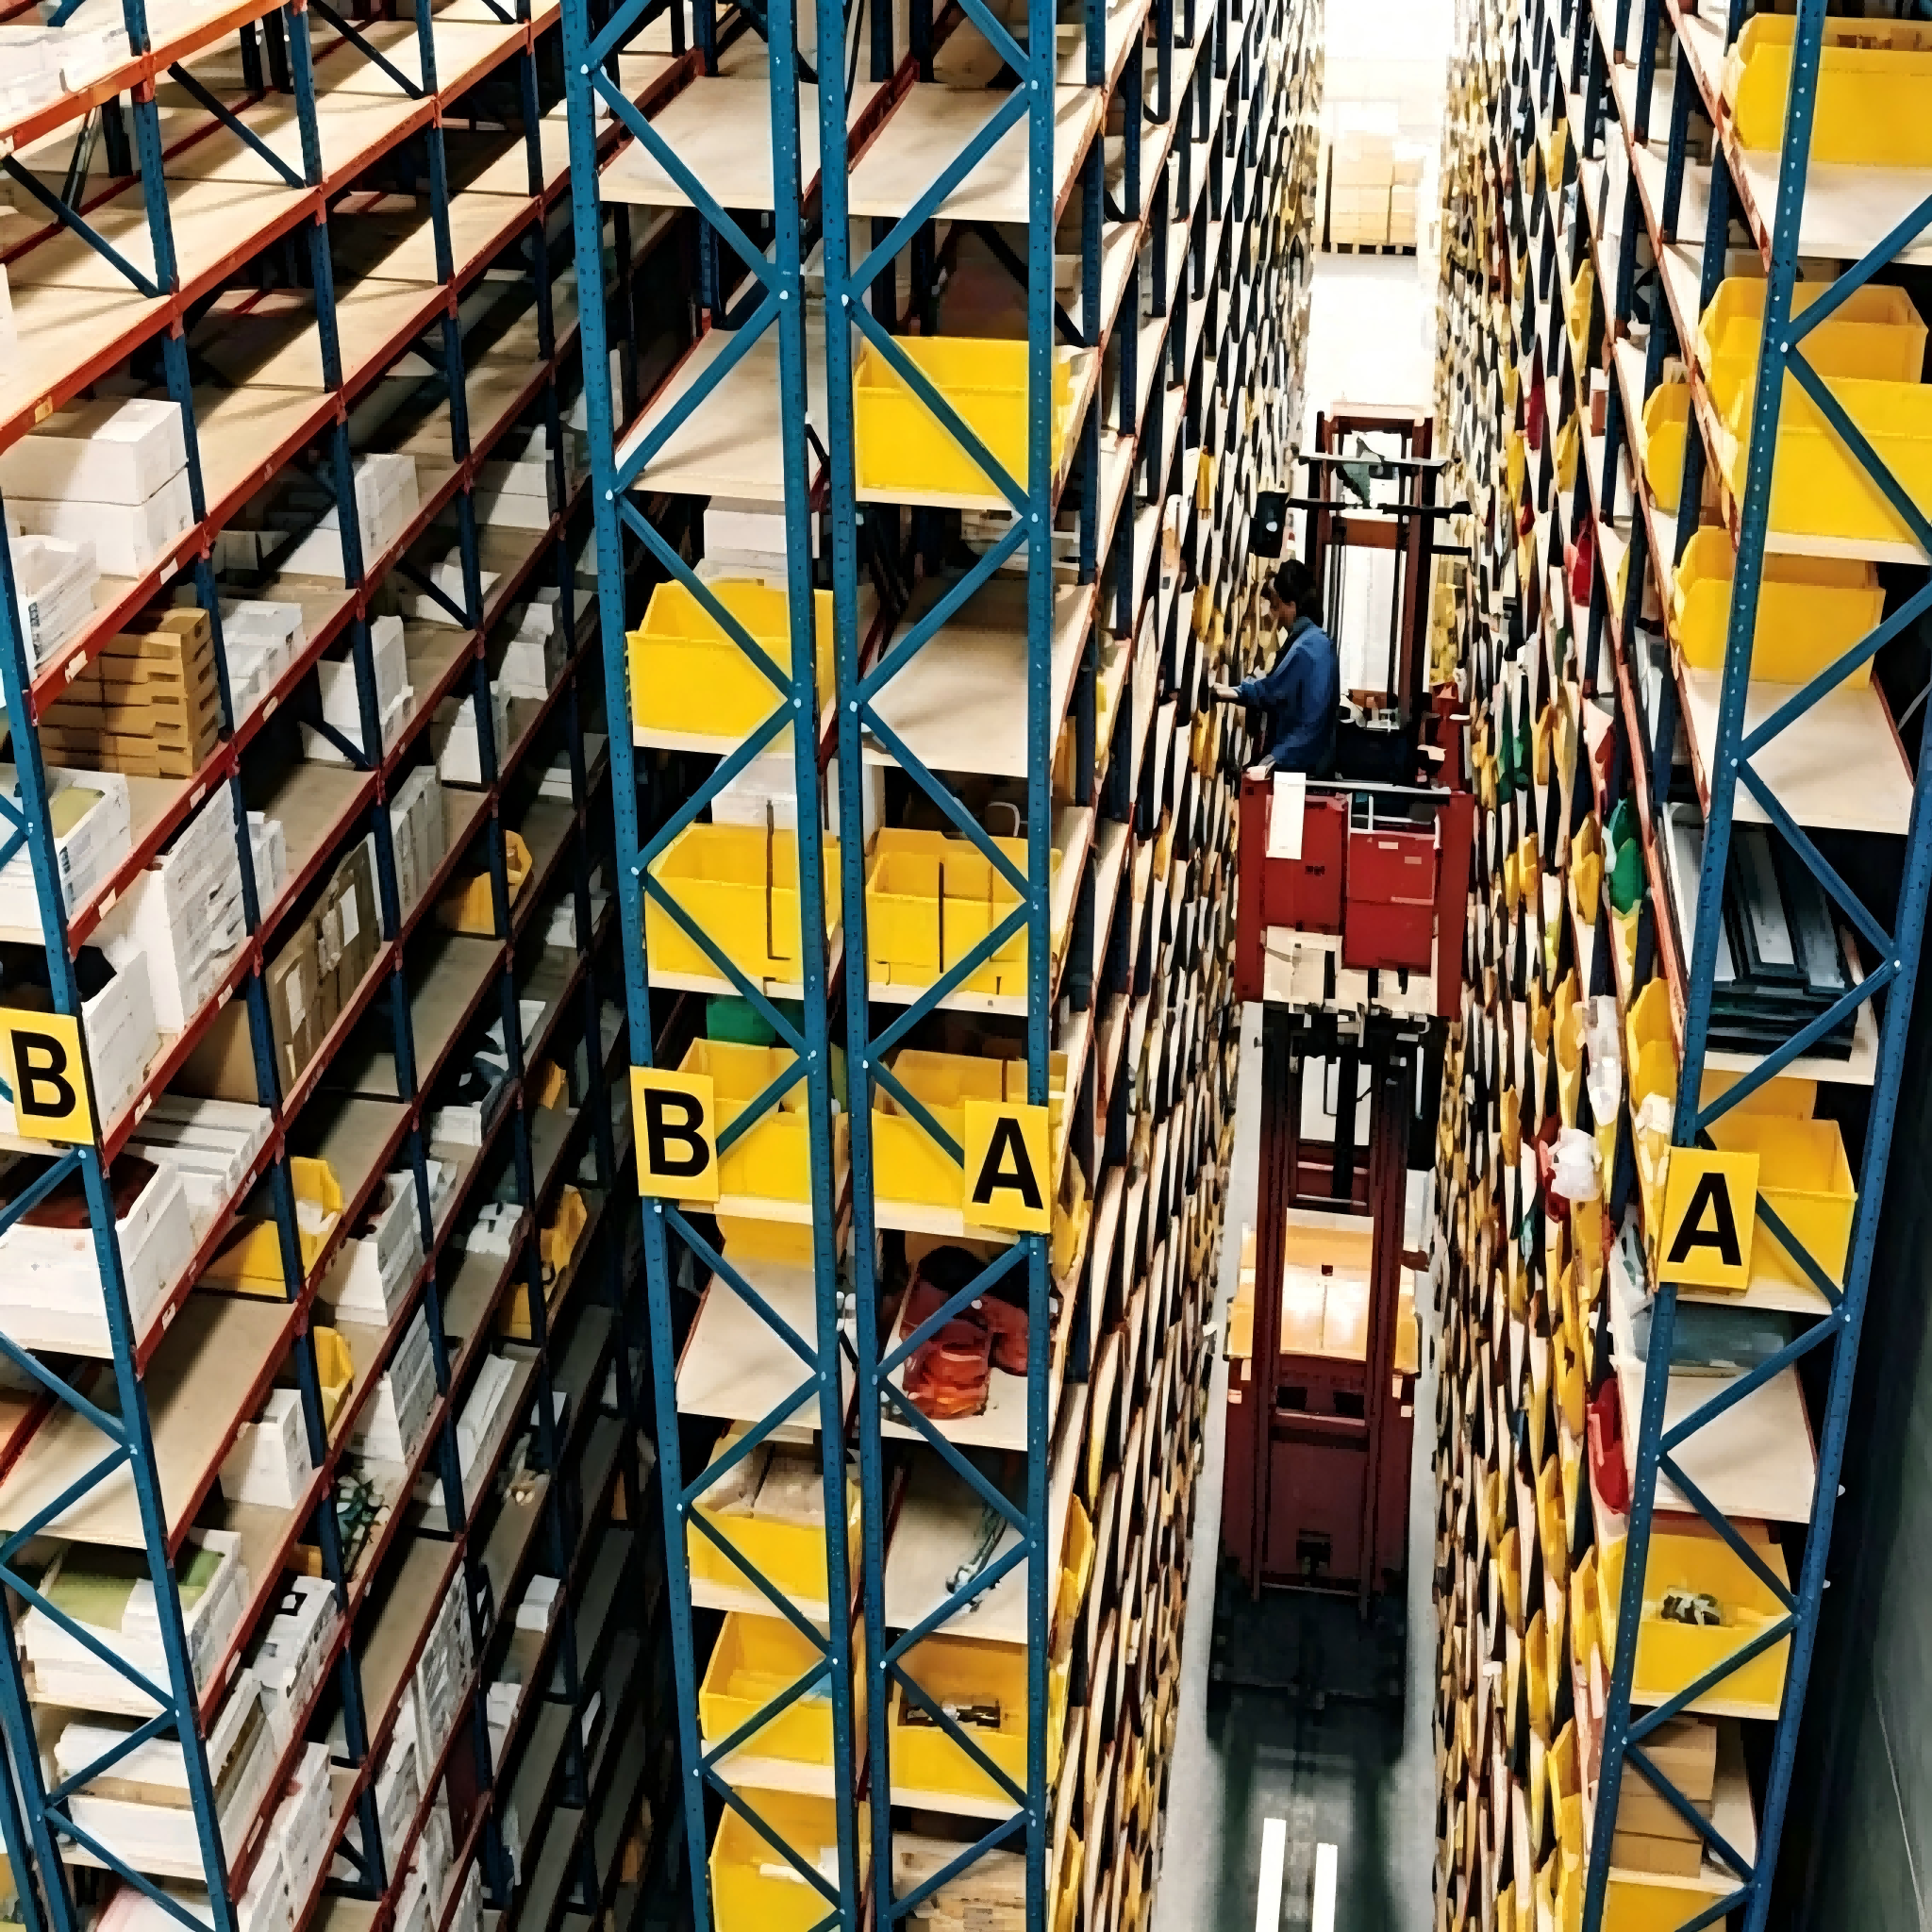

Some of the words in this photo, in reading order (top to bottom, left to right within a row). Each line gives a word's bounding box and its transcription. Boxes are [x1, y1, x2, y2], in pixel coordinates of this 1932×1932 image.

[11, 1030, 75, 1117] B
[644, 1089, 709, 1176] B
[972, 1117, 1043, 1209] A
[1667, 1173, 1741, 1266] A
